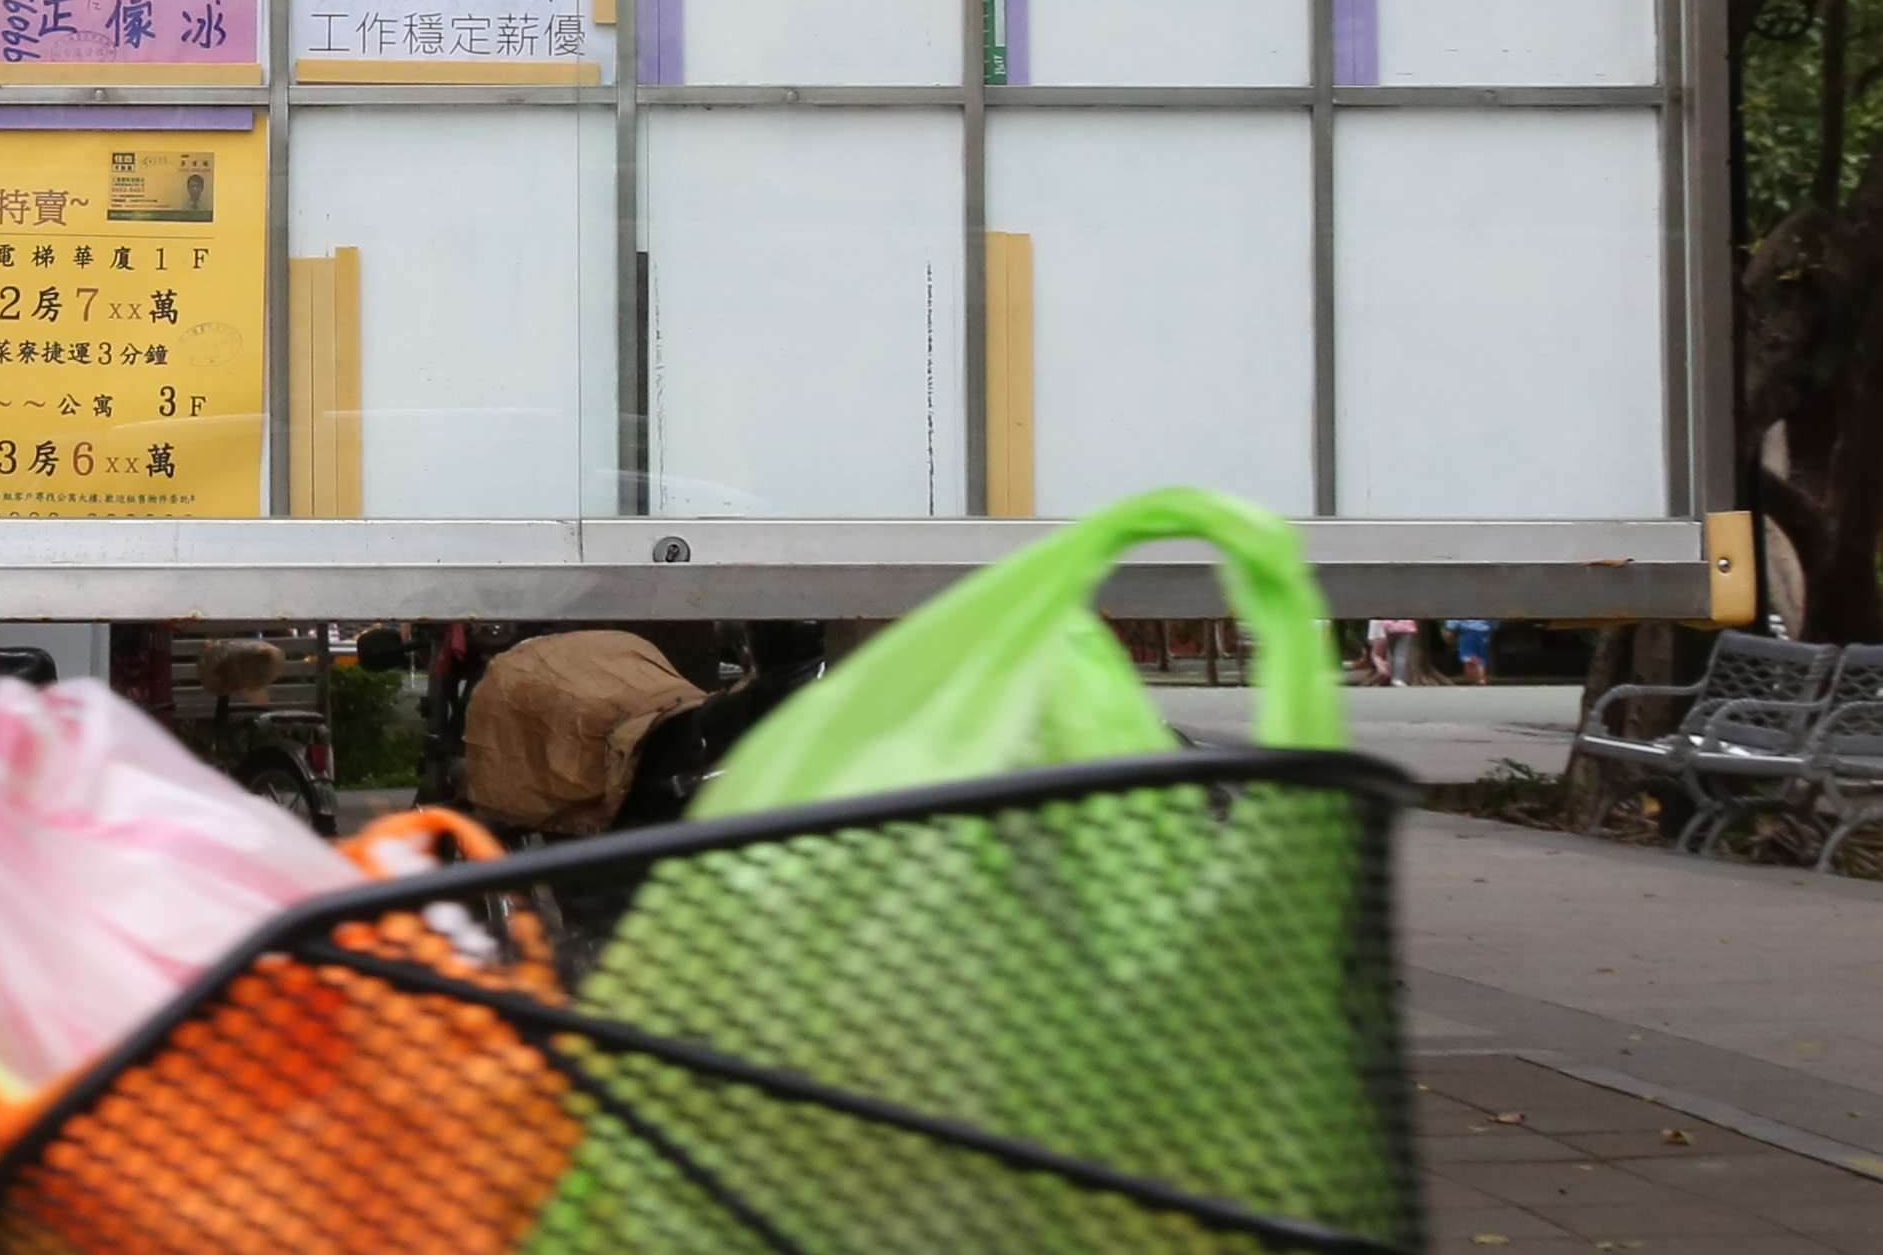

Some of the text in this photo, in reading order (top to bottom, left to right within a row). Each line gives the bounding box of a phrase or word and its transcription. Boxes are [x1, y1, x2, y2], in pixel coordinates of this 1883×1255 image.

[308, 10, 587, 58] 工作穩定薪優
